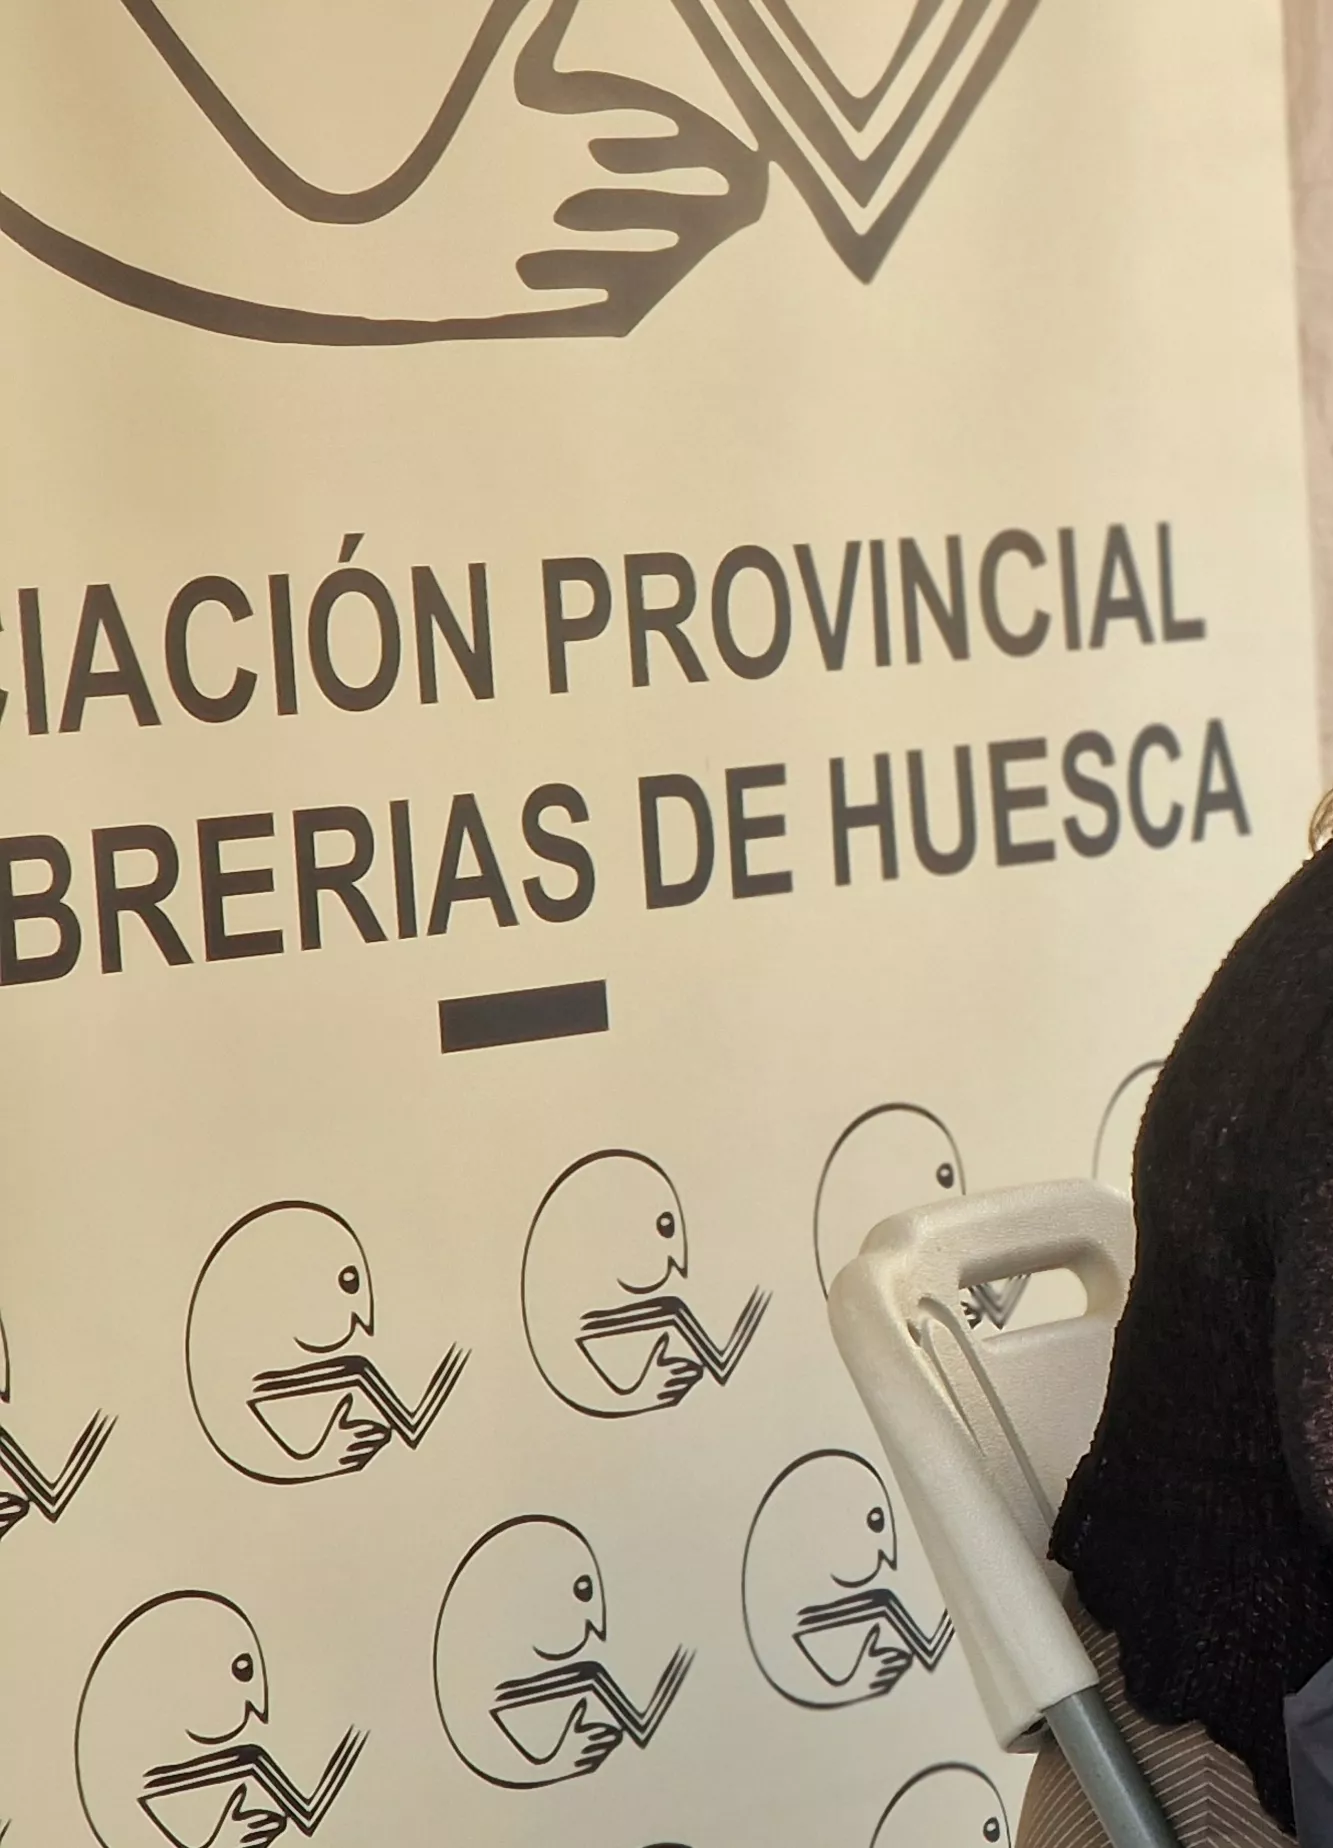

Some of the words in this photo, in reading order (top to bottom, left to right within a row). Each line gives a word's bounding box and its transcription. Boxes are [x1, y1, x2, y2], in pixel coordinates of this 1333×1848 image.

[0, 532, 496, 736] IACIÓN
[541, 520, 1207, 697] PROVINCIAL
[0, 781, 598, 987] BRERIAS
[637, 762, 795, 911] DE
[828, 716, 1252, 887] HUESCA
